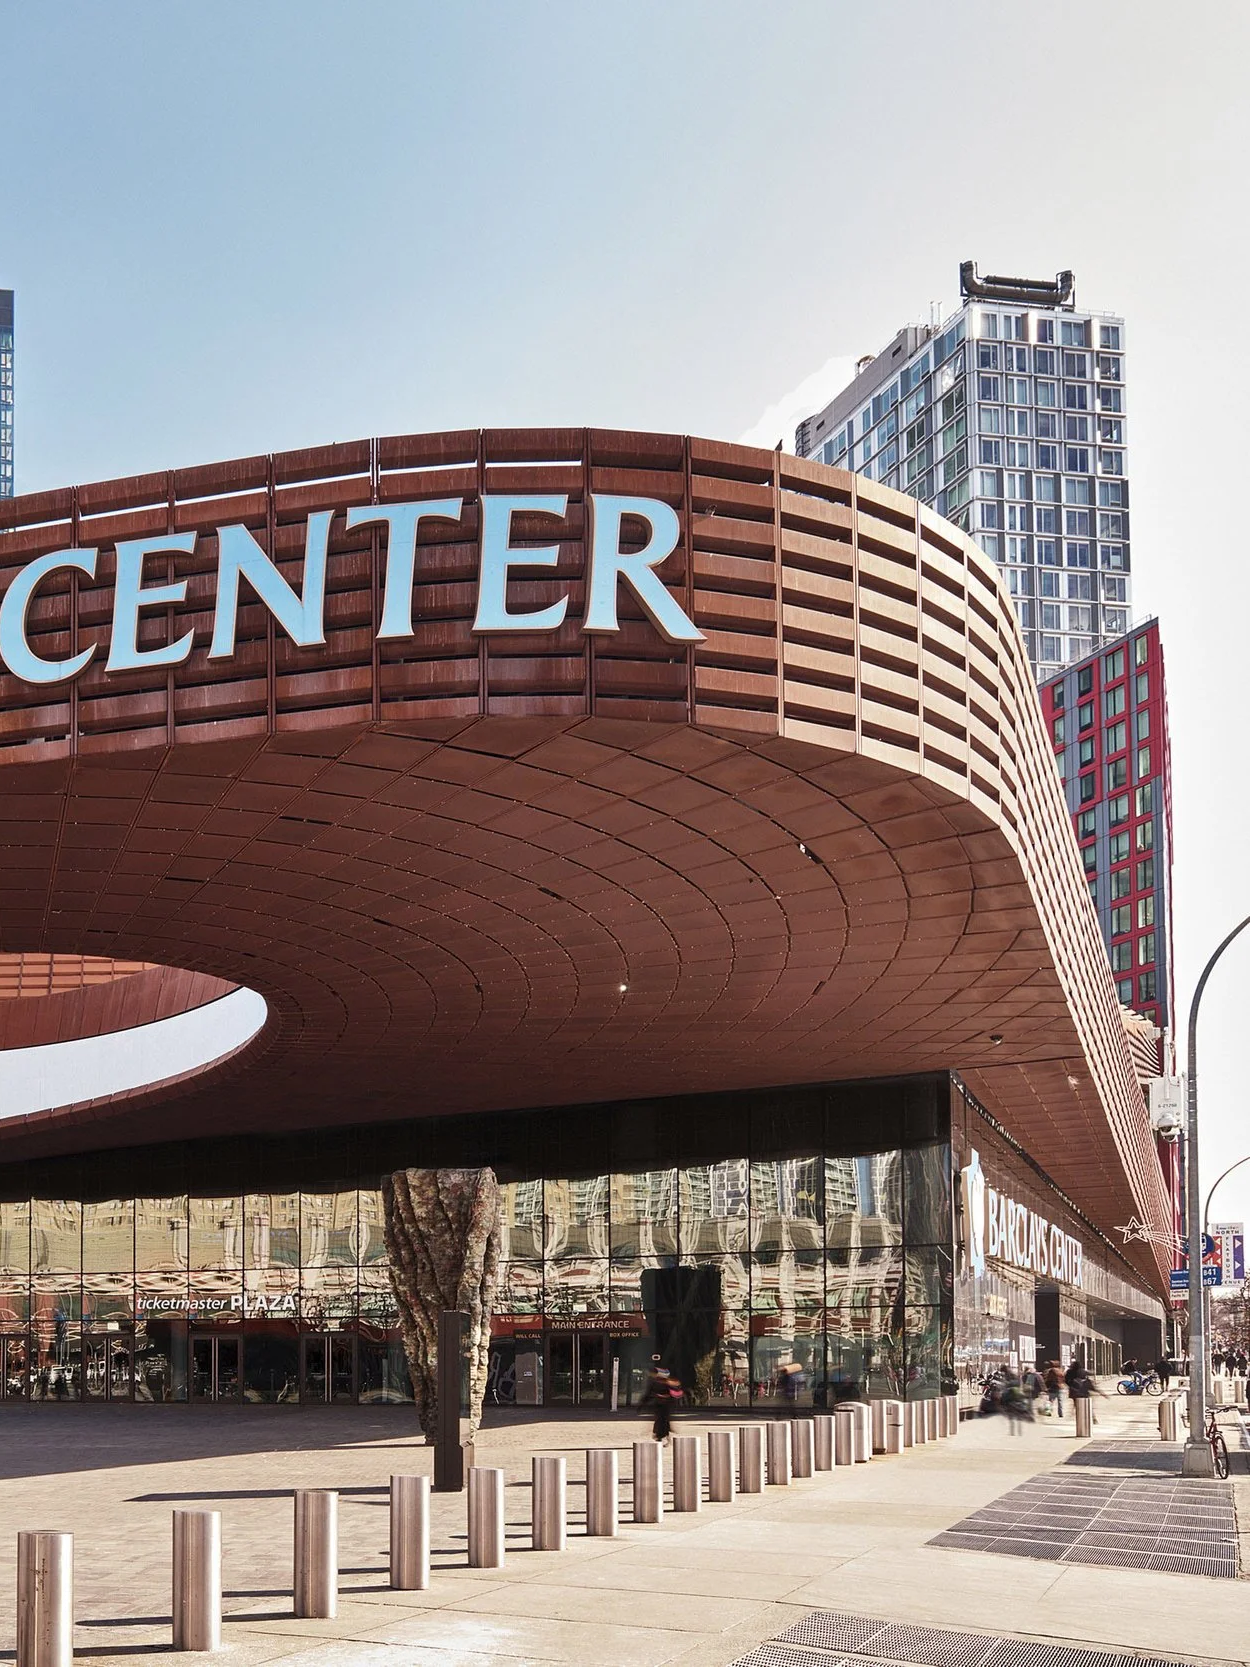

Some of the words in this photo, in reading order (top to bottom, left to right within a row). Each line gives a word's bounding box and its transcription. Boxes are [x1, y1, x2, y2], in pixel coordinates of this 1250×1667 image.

[988, 1187, 1049, 1275] BARCLAYS
[1049, 1223, 1083, 1290] CENTER
[1203, 1268, 1217, 1276] B41
[1203, 1277, 1217, 1286] B67
[137, 1296, 228, 1311] ticketmaster
[230, 1295, 296, 1311] PLAZA
[551, 1321, 576, 1329] MAIN
[578, 1320, 630, 1329] ENTRANCE
